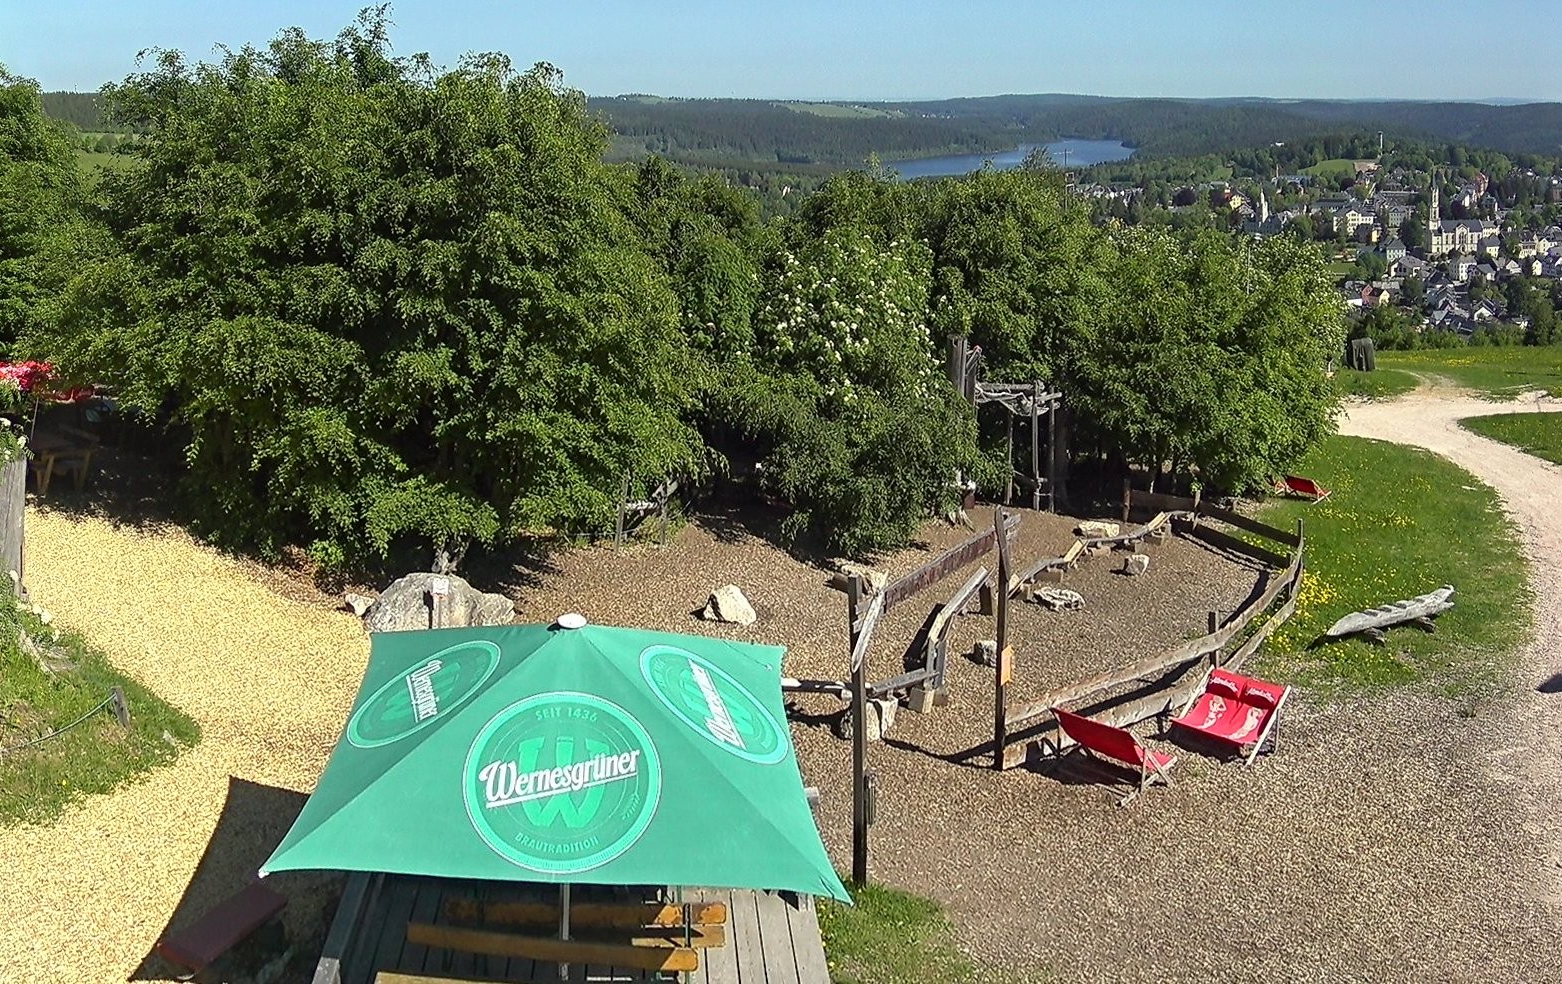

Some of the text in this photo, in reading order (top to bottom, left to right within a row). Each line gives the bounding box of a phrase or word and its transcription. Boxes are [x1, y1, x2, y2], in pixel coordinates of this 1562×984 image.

[535, 707, 598, 722] SEIT 1436
[478, 749, 641, 804] Wernesgrüner
[514, 832, 599, 854] BRAUTRADITION
